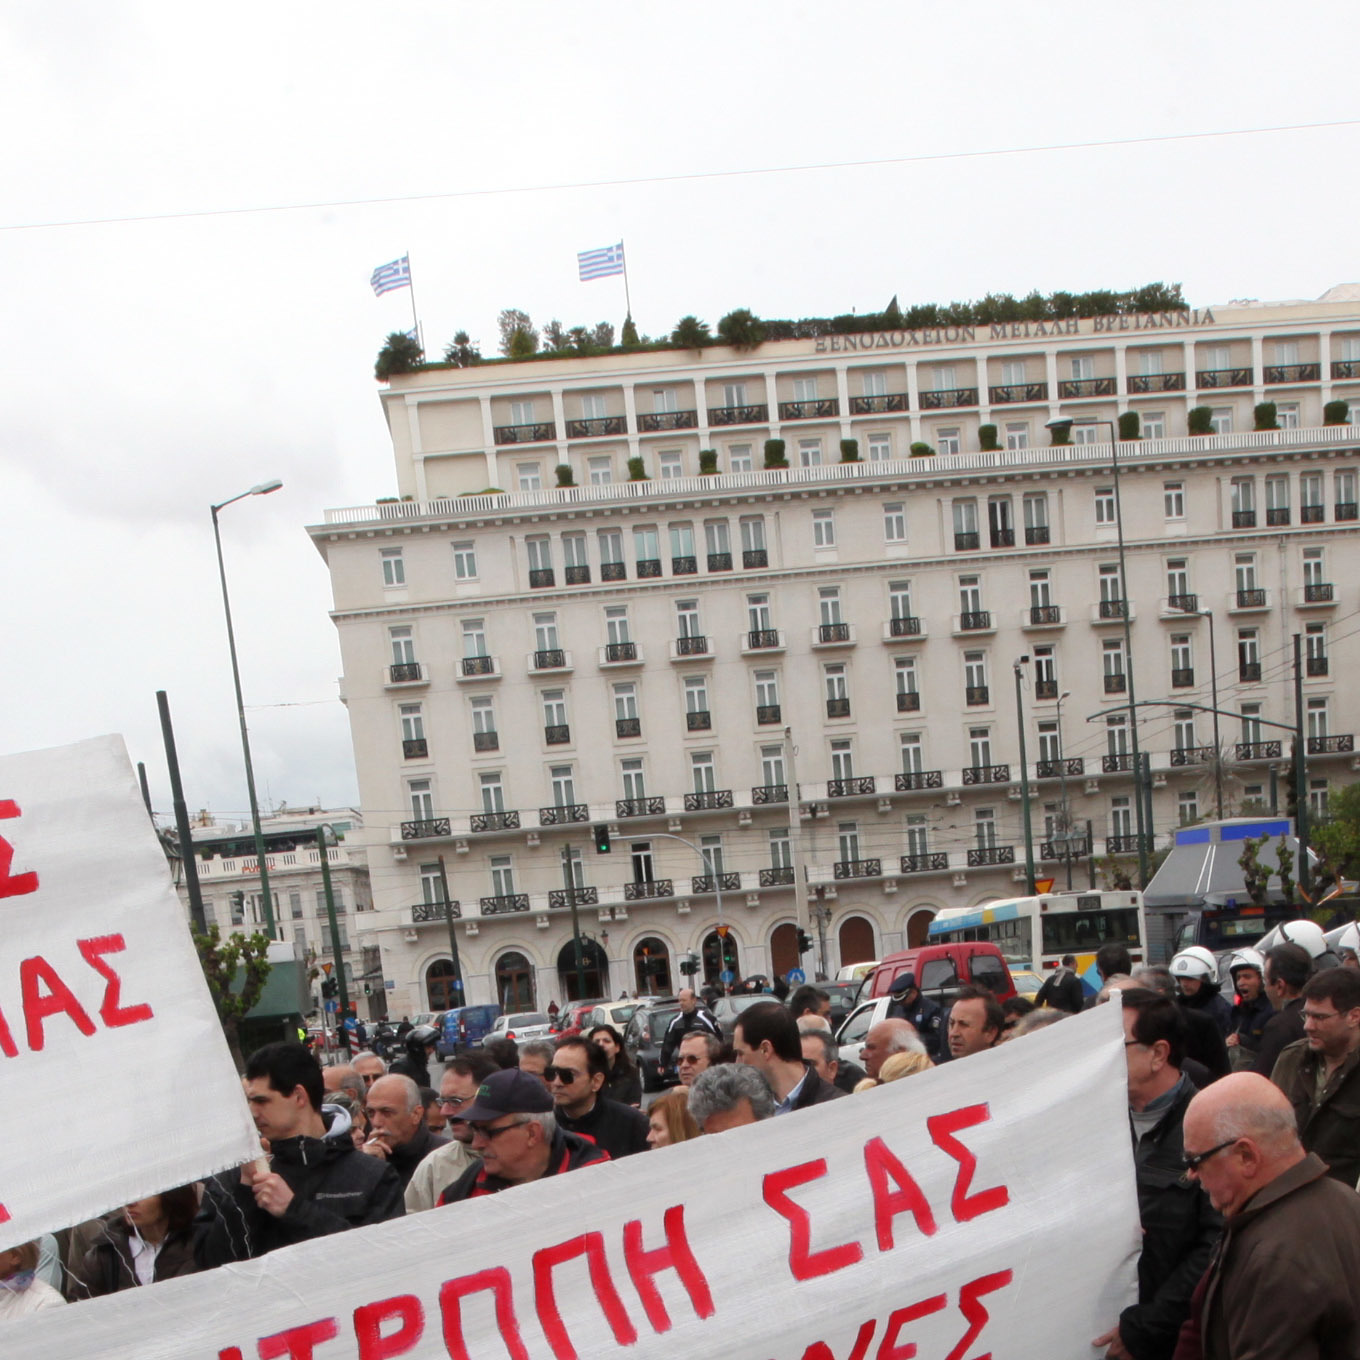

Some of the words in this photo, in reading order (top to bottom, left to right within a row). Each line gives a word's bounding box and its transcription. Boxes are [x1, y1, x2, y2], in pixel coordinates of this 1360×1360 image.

[814, 325, 976, 353] ΞΕΝΟΔΟΧΕΙΟΝ
[1093, 307, 1216, 333] ΒΡΕΤΑΝΝΙΑ
[762, 1103, 1011, 1282] ΣΑΣ
